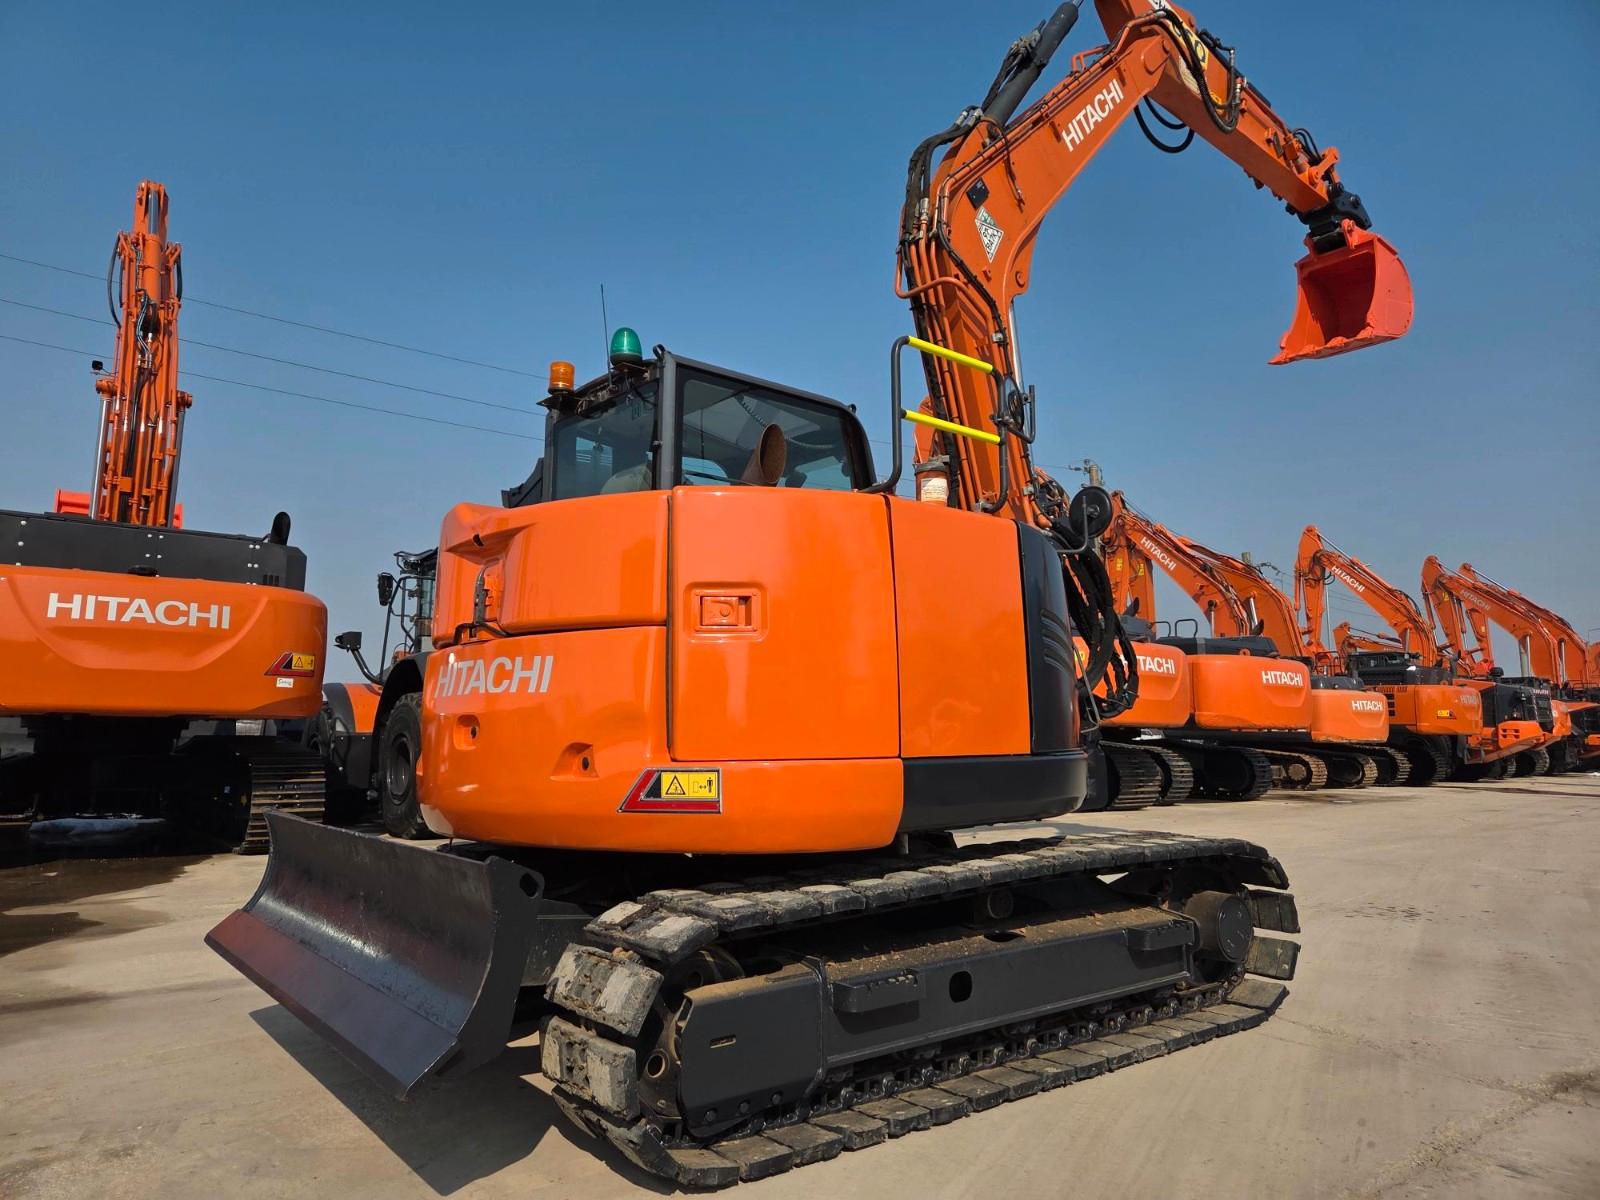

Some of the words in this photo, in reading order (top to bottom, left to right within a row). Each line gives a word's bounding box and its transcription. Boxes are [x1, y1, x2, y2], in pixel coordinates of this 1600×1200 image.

[1061, 79, 1124, 152] HITACHI
[1141, 537, 1176, 571] HITACHI
[1331, 565, 1366, 592] HITACHI
[47, 592, 231, 630] HITACHI
[434, 656, 554, 698] HITACHI
[1262, 671, 1303, 686] HITACHI
